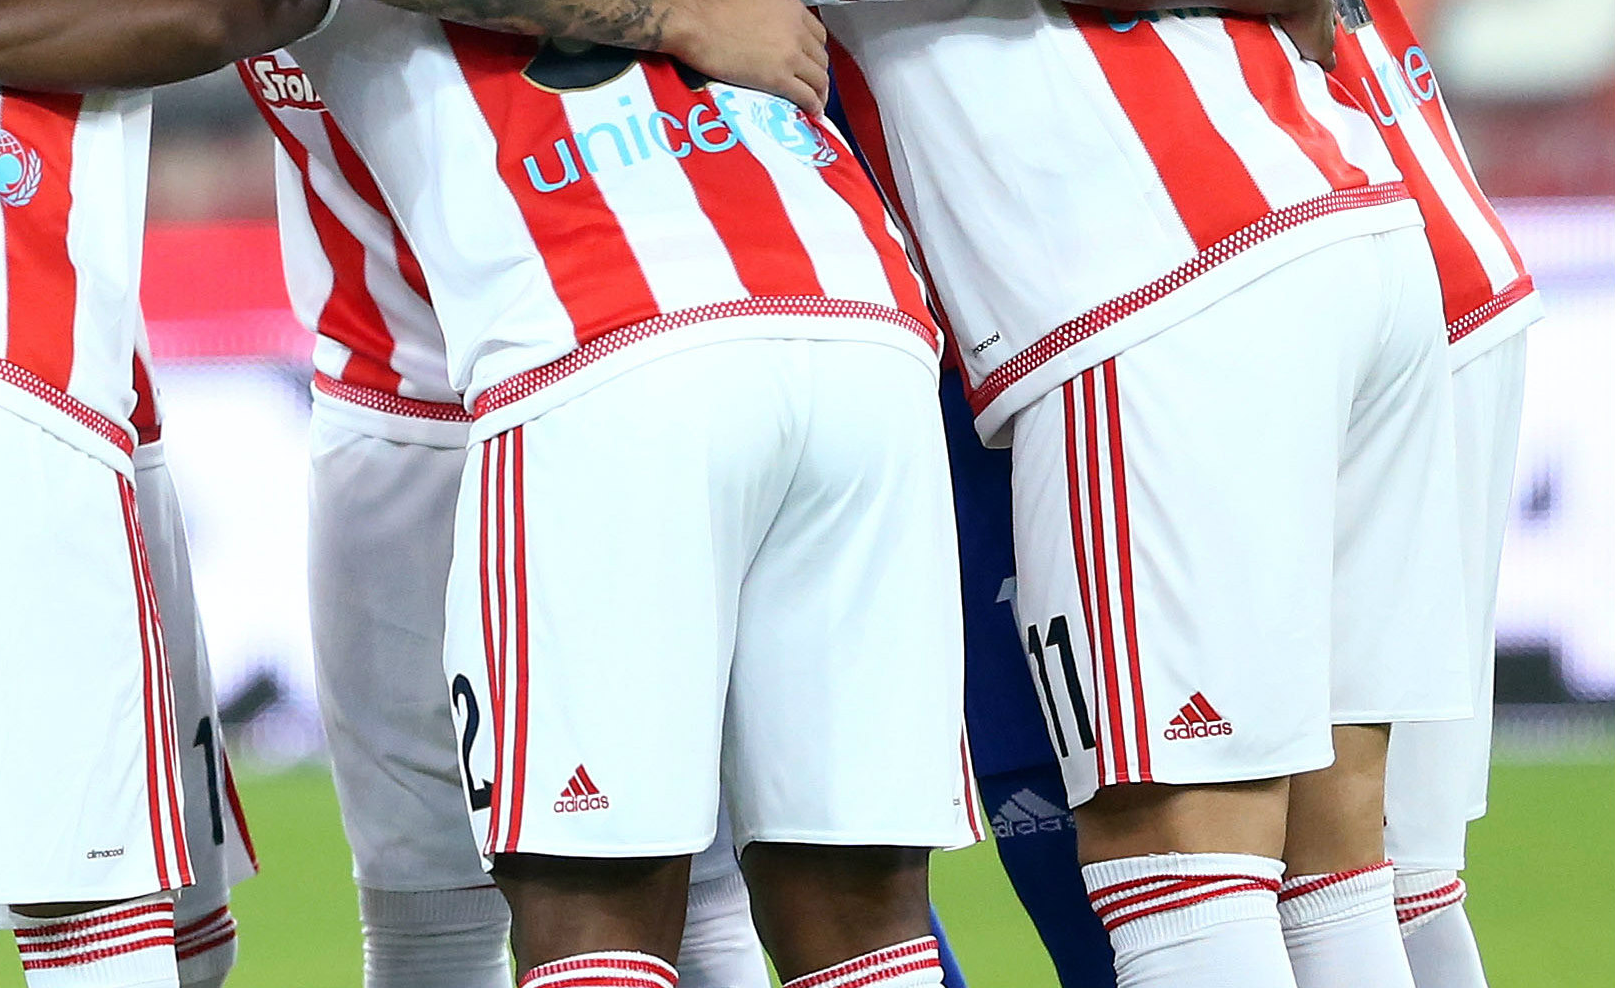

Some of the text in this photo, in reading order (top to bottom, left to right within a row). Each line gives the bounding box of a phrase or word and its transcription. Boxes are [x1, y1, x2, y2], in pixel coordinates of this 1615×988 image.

[522, 90, 752, 193] unicef
[1027, 614, 1097, 758] 11
[1163, 719, 1234, 741] adidas
[553, 794, 611, 814] adidas
